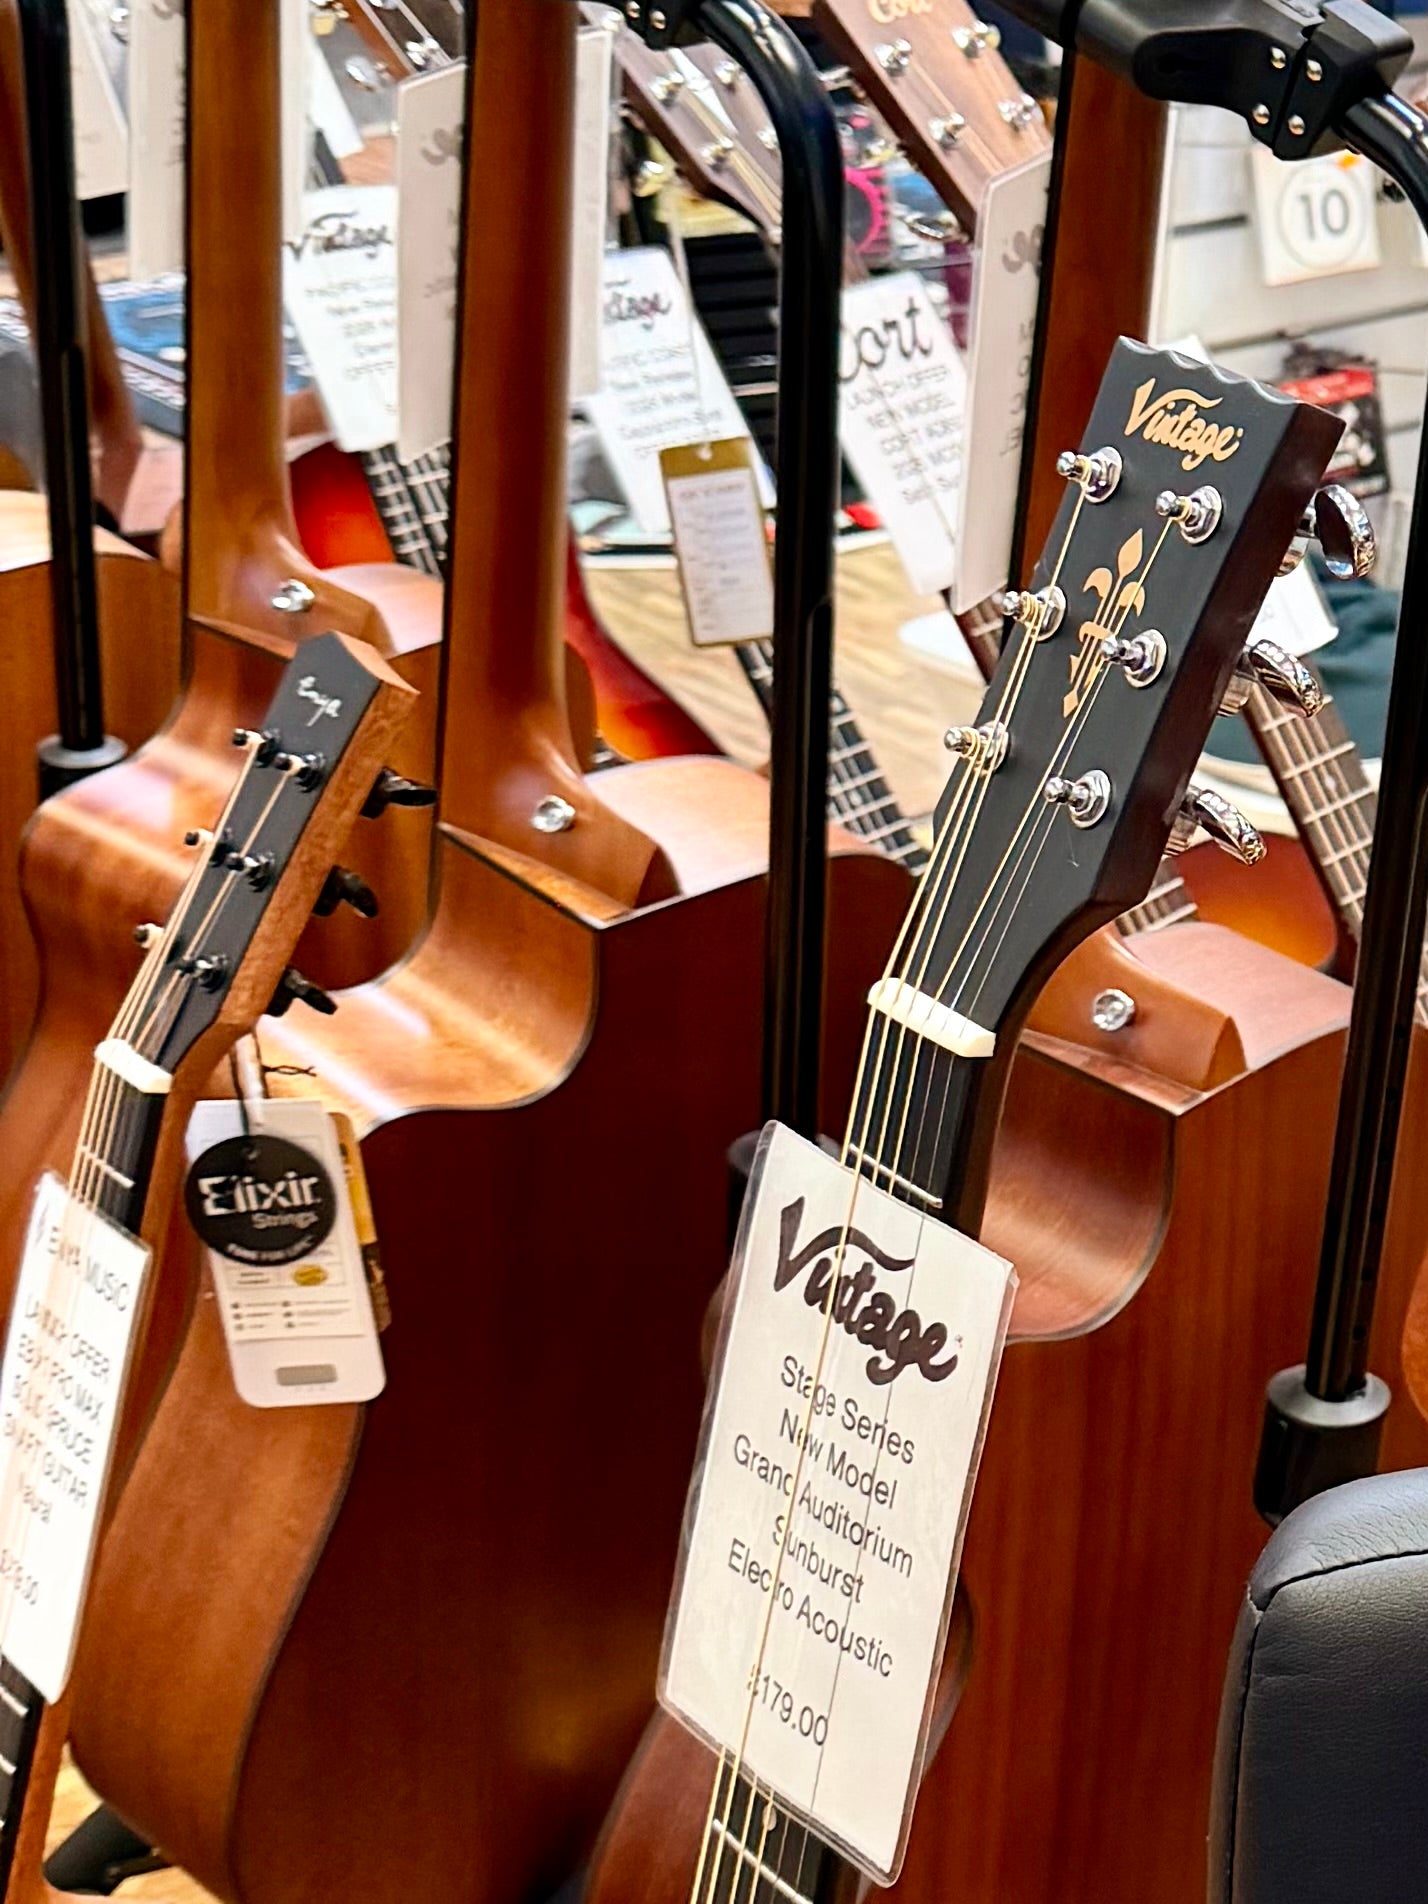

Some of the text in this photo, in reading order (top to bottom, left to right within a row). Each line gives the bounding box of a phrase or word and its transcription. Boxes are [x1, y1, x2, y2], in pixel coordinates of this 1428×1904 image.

[1296, 188, 1349, 241] 10
[1124, 377, 1244, 471] Vintage
[198, 1171, 322, 1217] Elixir
[772, 1196, 959, 1385] Vintage
[779, 1355, 916, 1464] Stage Series
[779, 1407, 898, 1509] New Model
[732, 1434, 914, 1579] Grand Auditorium
[770, 1516, 864, 1604] Sunburst
[796, 1590, 893, 1678] Acoustic
